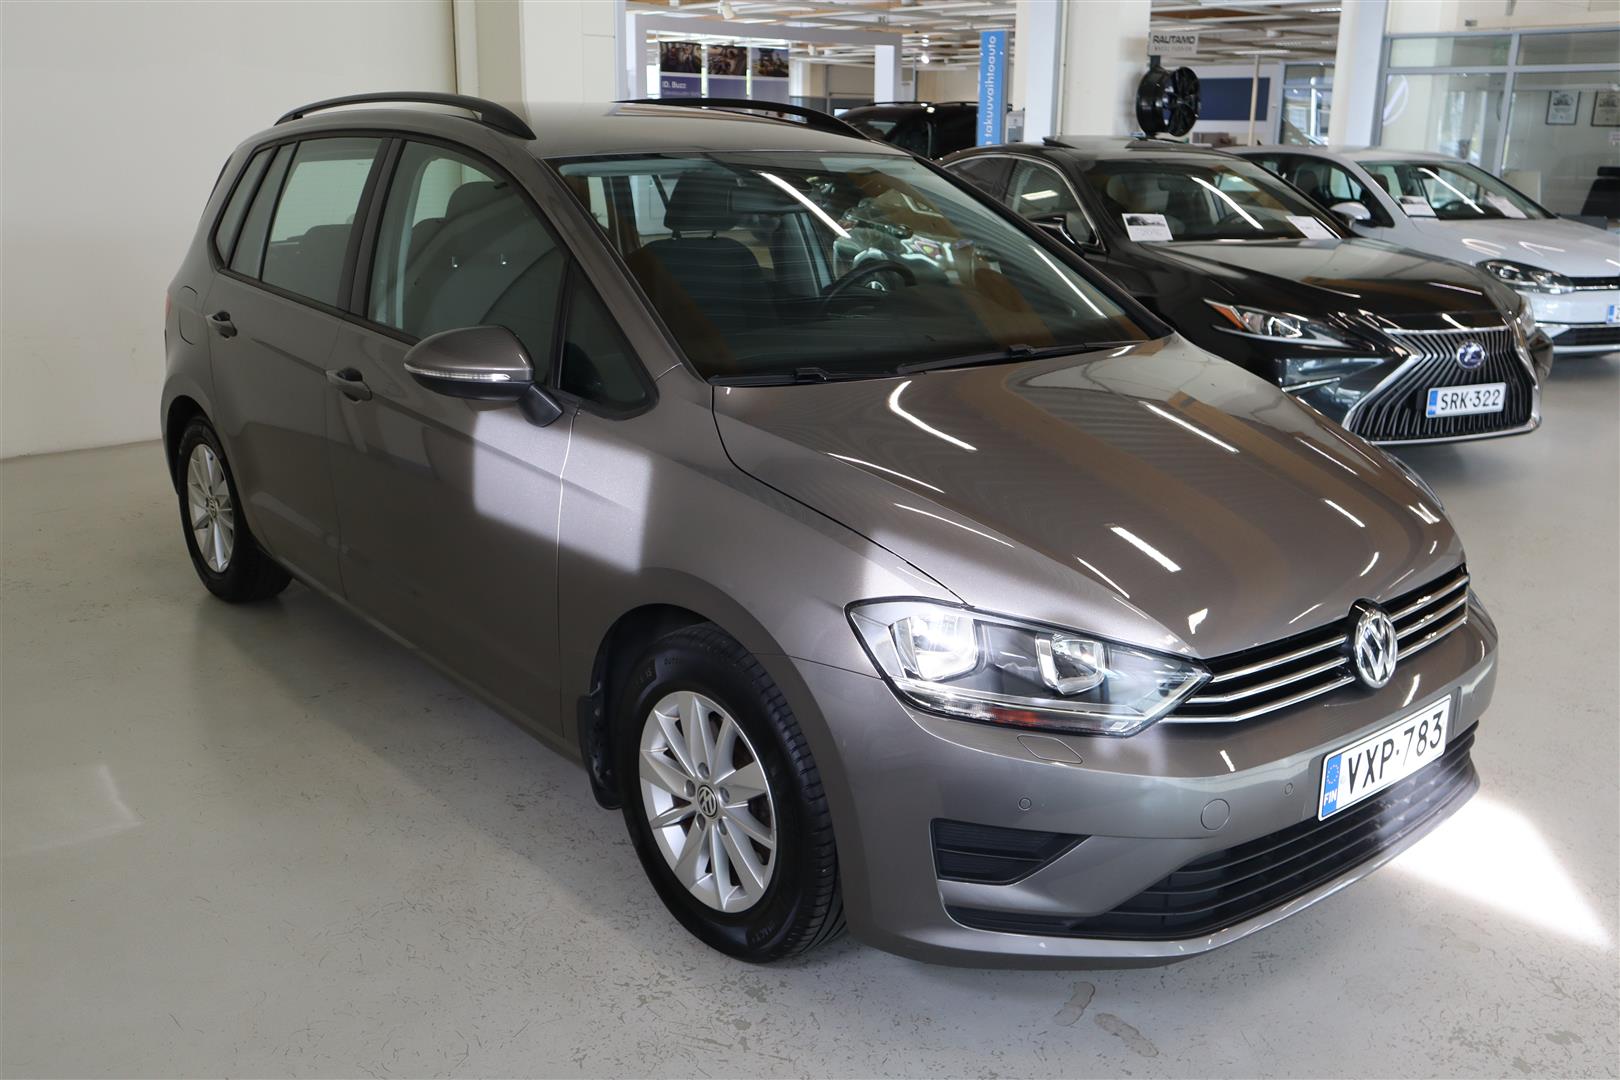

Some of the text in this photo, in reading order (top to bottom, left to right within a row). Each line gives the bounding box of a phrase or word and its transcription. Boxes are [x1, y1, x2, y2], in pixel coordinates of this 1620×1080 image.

[1153, 34, 1196, 45] RAUTAMO
[984, 35, 997, 137] takuuvaihtoauto
[1440, 389, 1501, 411] SRK-322
[1348, 710, 1444, 795] VXP-783
[1323, 788, 1338, 806] FIN
